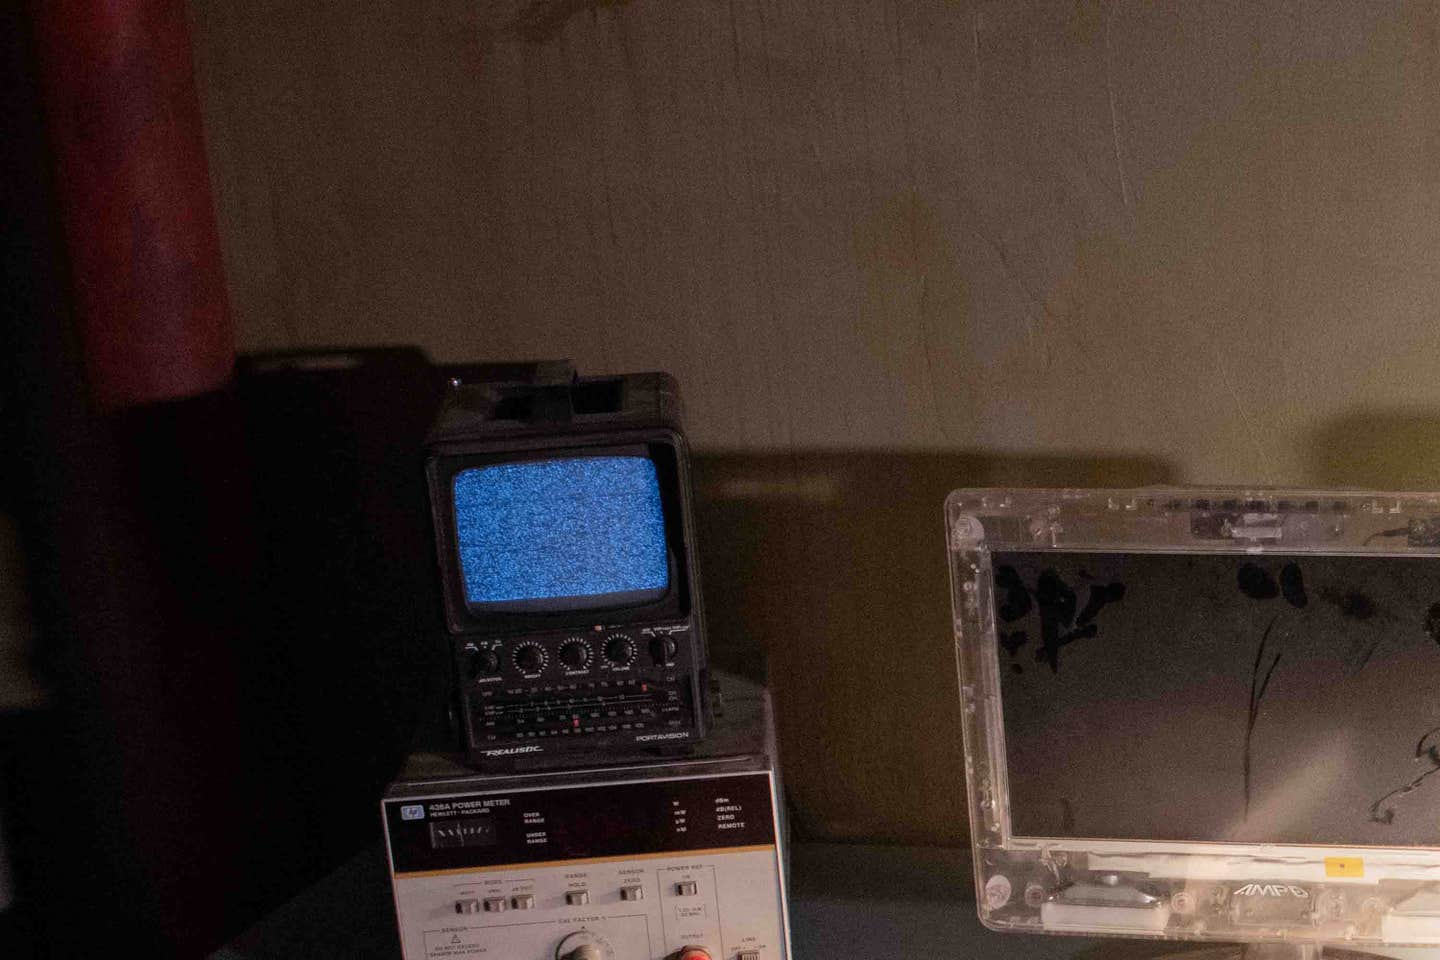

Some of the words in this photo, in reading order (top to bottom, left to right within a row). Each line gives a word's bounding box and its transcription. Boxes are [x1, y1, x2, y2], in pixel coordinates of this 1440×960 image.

[636, 731, 689, 742] PORTAVISION
[480, 745, 544, 757] REALISTIC
[452, 800, 482, 810] POWER
[483, 798, 511, 808] METER
[667, 864, 690, 872] POWER
[572, 916, 600, 924] FACTOR
